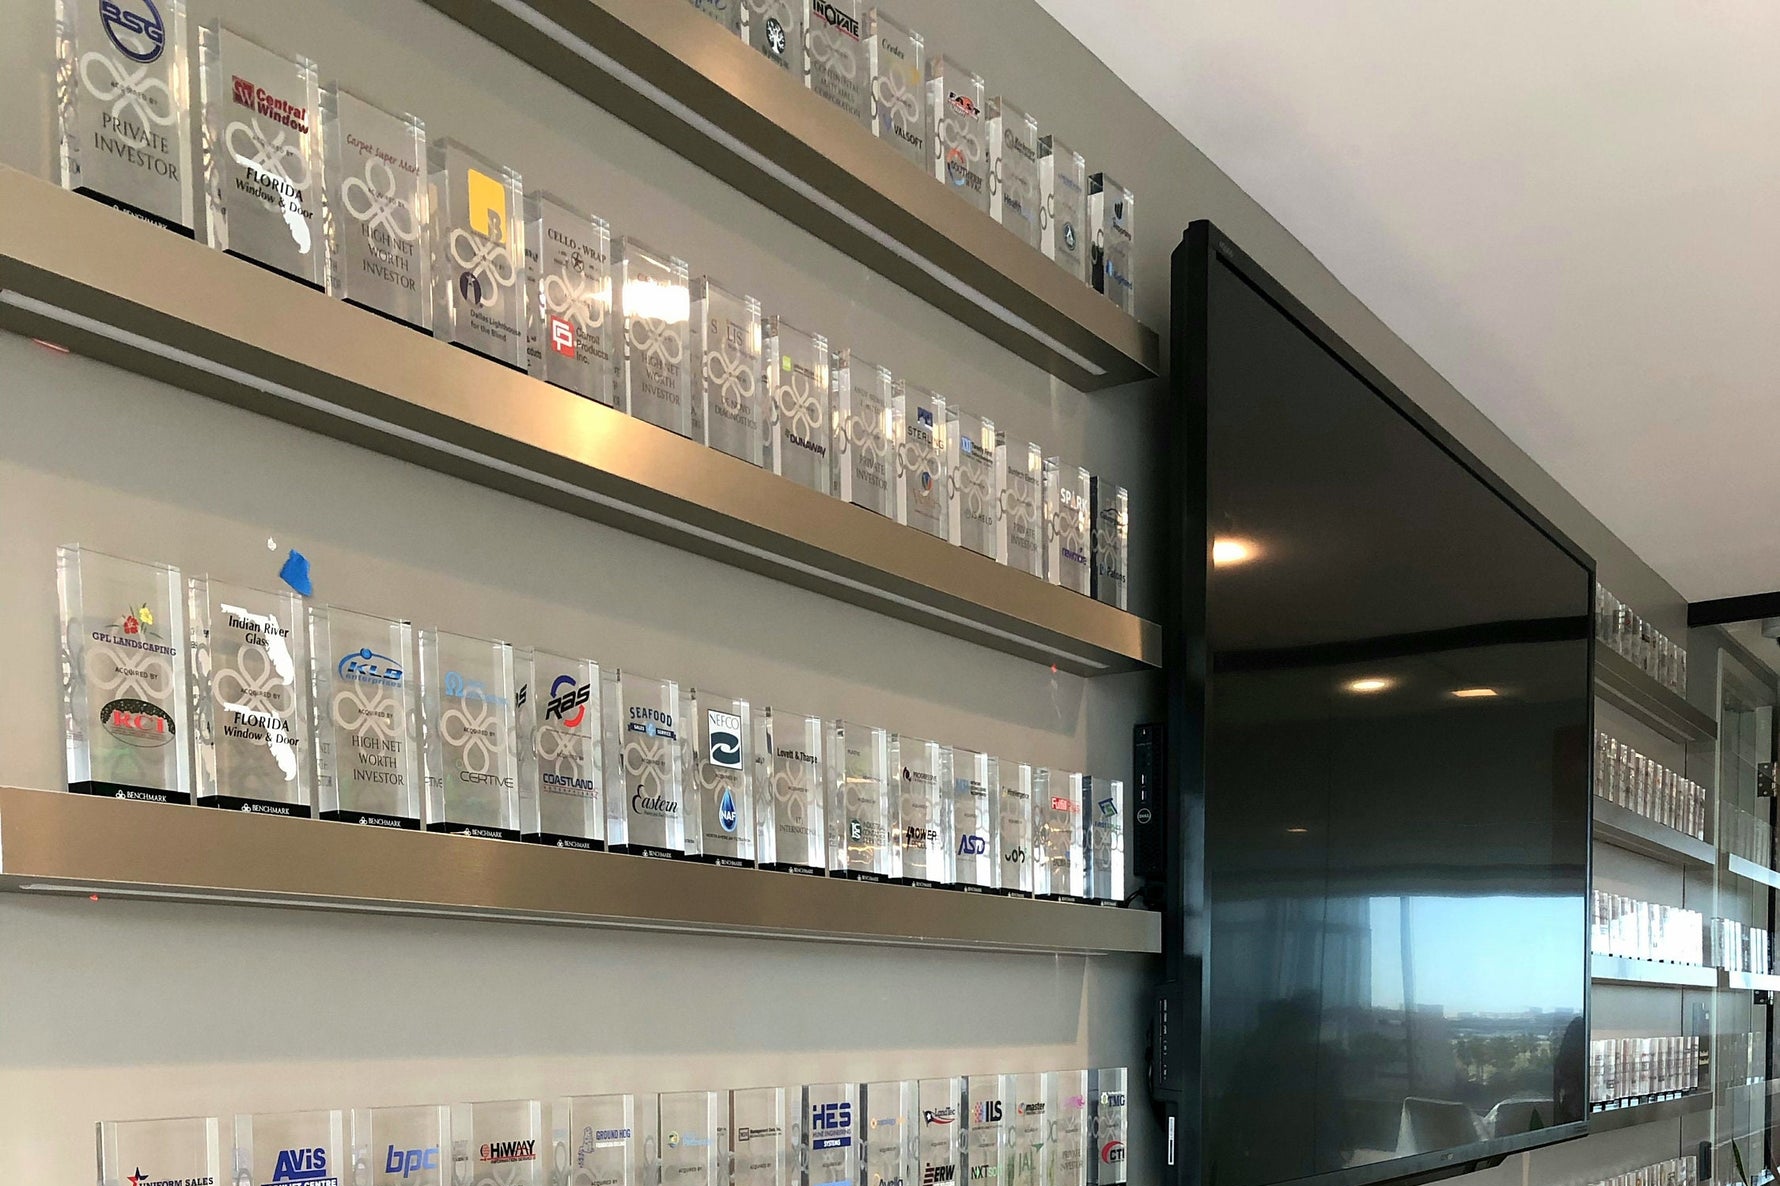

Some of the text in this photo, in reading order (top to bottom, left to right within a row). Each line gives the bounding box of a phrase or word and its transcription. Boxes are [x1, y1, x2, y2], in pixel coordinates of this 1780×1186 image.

[102, 2, 164, 43] BSG
[256, 88, 306, 120] Central
[257, 104, 309, 134] Window
[102, 112, 168, 154] PRIVATE
[894, 125, 923, 149] VALSOFT
[94, 132, 179, 182] INVESTOR
[346, 134, 420, 177] Carpet Super Mart
[246, 167, 304, 202] FLORIDA
[235, 178, 314, 220] Window & Door
[361, 224, 414, 256] HIGH NET
[548, 228, 606, 264] CELLO WRAP
[368, 244, 409, 272] WORTH
[362, 260, 416, 291] INVESTOR
[470, 309, 521, 337] Dallas Lighthouse
[490, 326, 506, 342] Blind
[576, 339, 608, 360] Products
[641, 382, 680, 405] INVESTOR
[790, 433, 826, 458] DUNAWAY
[907, 425, 944, 449] STERLING
[856, 469, 888, 491] INVESTOR
[1060, 488, 1088, 509] SPARK
[229, 615, 289, 638] Indian River
[92, 632, 177, 657] GPL LANDSCAPING
[245, 632, 269, 646] Glass
[115, 667, 148, 678] ACQUIRED
[346, 673, 402, 688] enterprises
[234, 712, 289, 732] FLORIDA
[629, 706, 673, 727] SEAFOOD
[710, 713, 739, 730] NEFCO
[224, 725, 299, 747] Window & Door
[352, 735, 402, 753] HIGH NET
[359, 753, 396, 769] WORTH
[353, 769, 404, 786] INVESTOR
[460, 771, 514, 788] CERTIVE
[543, 773, 593, 790] COASTLAND
[127, 791, 167, 802] BENCHMARK
[632, 784, 677, 814] Eastern
[252, 804, 289, 815] BENCHMARK
[722, 810, 736, 821] NAF
[368, 817, 401, 827] BENCHMARK
[472, 829, 502, 838] BENCHMARK
[1025, 1102, 1045, 1111] master
[1108, 1094, 1125, 1107] TMG
[813, 1103, 851, 1130] HES
[986, 1101, 1002, 1122] ILS
[596, 1129, 630, 1140] GROUND HOG
[386, 1145, 437, 1178] bpc
[1110, 1149, 1125, 1161] CTI
[934, 1164, 955, 1183] ERW
